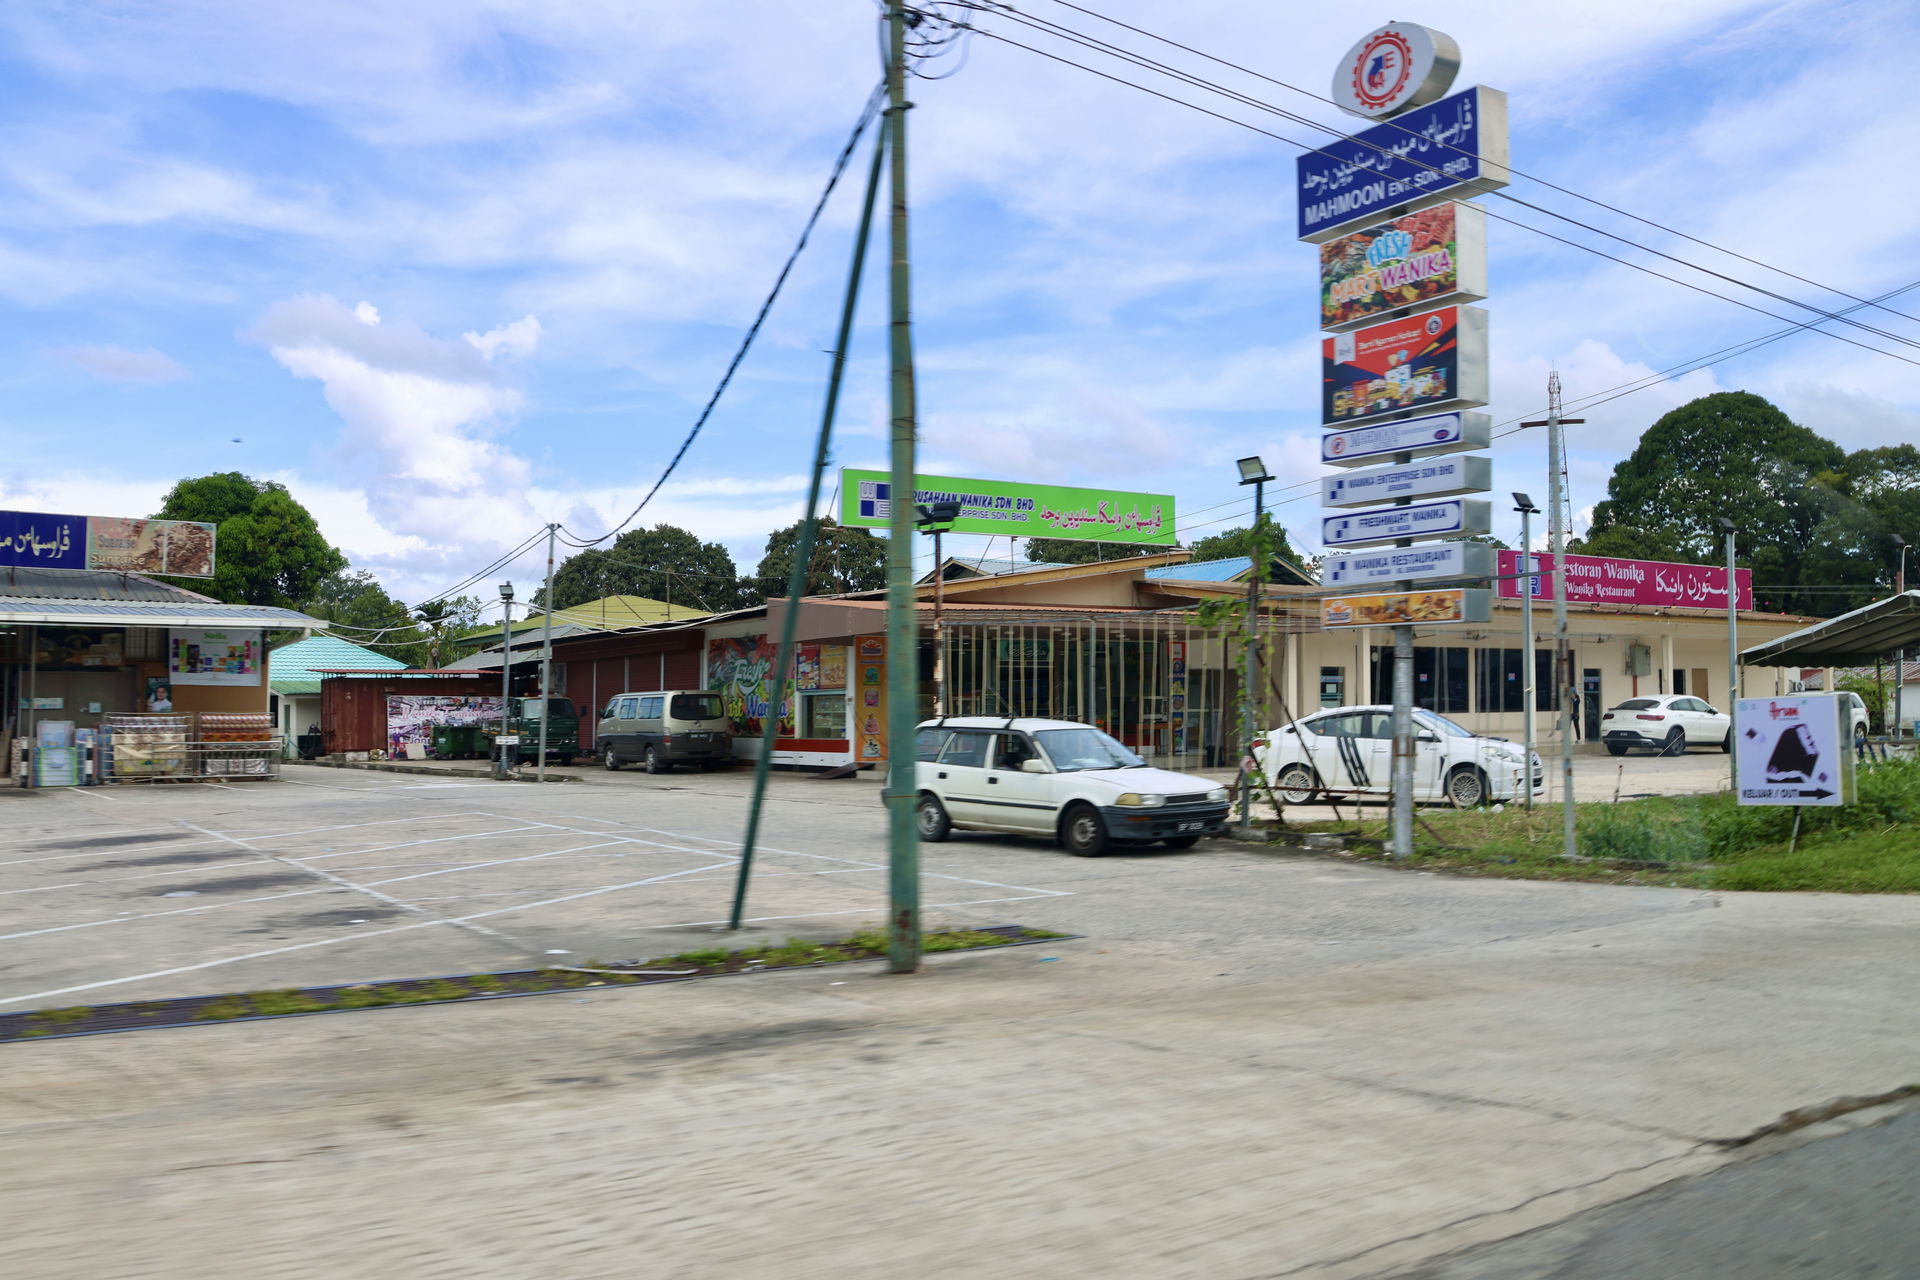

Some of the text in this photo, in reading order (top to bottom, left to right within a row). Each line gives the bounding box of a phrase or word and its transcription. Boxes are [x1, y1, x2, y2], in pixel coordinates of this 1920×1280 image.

[1305, 180, 1386, 226] MAHMOON
[1366, 230, 1413, 268] FRESH
[1330, 249, 1452, 306] MART WANIKA
[1377, 469, 1420, 484] ENTERPRISE
[913, 491, 1036, 511] RUSAHAAN WANIKA SDN. BHD.
[991, 511, 1009, 521] SDN.
[1011, 512, 1030, 522] BHD.
[90, 552, 146, 566] Sunraise
[1353, 557, 1388, 570] WANIKA
[1390, 549, 1453, 566] RESTAURANT
[1556, 561, 1645, 584] estoran Wanika
[1564, 581, 1635, 598] Wanika Restaurant
[745, 694, 788, 718] Wana
[1742, 789, 1773, 799] KELUAR
